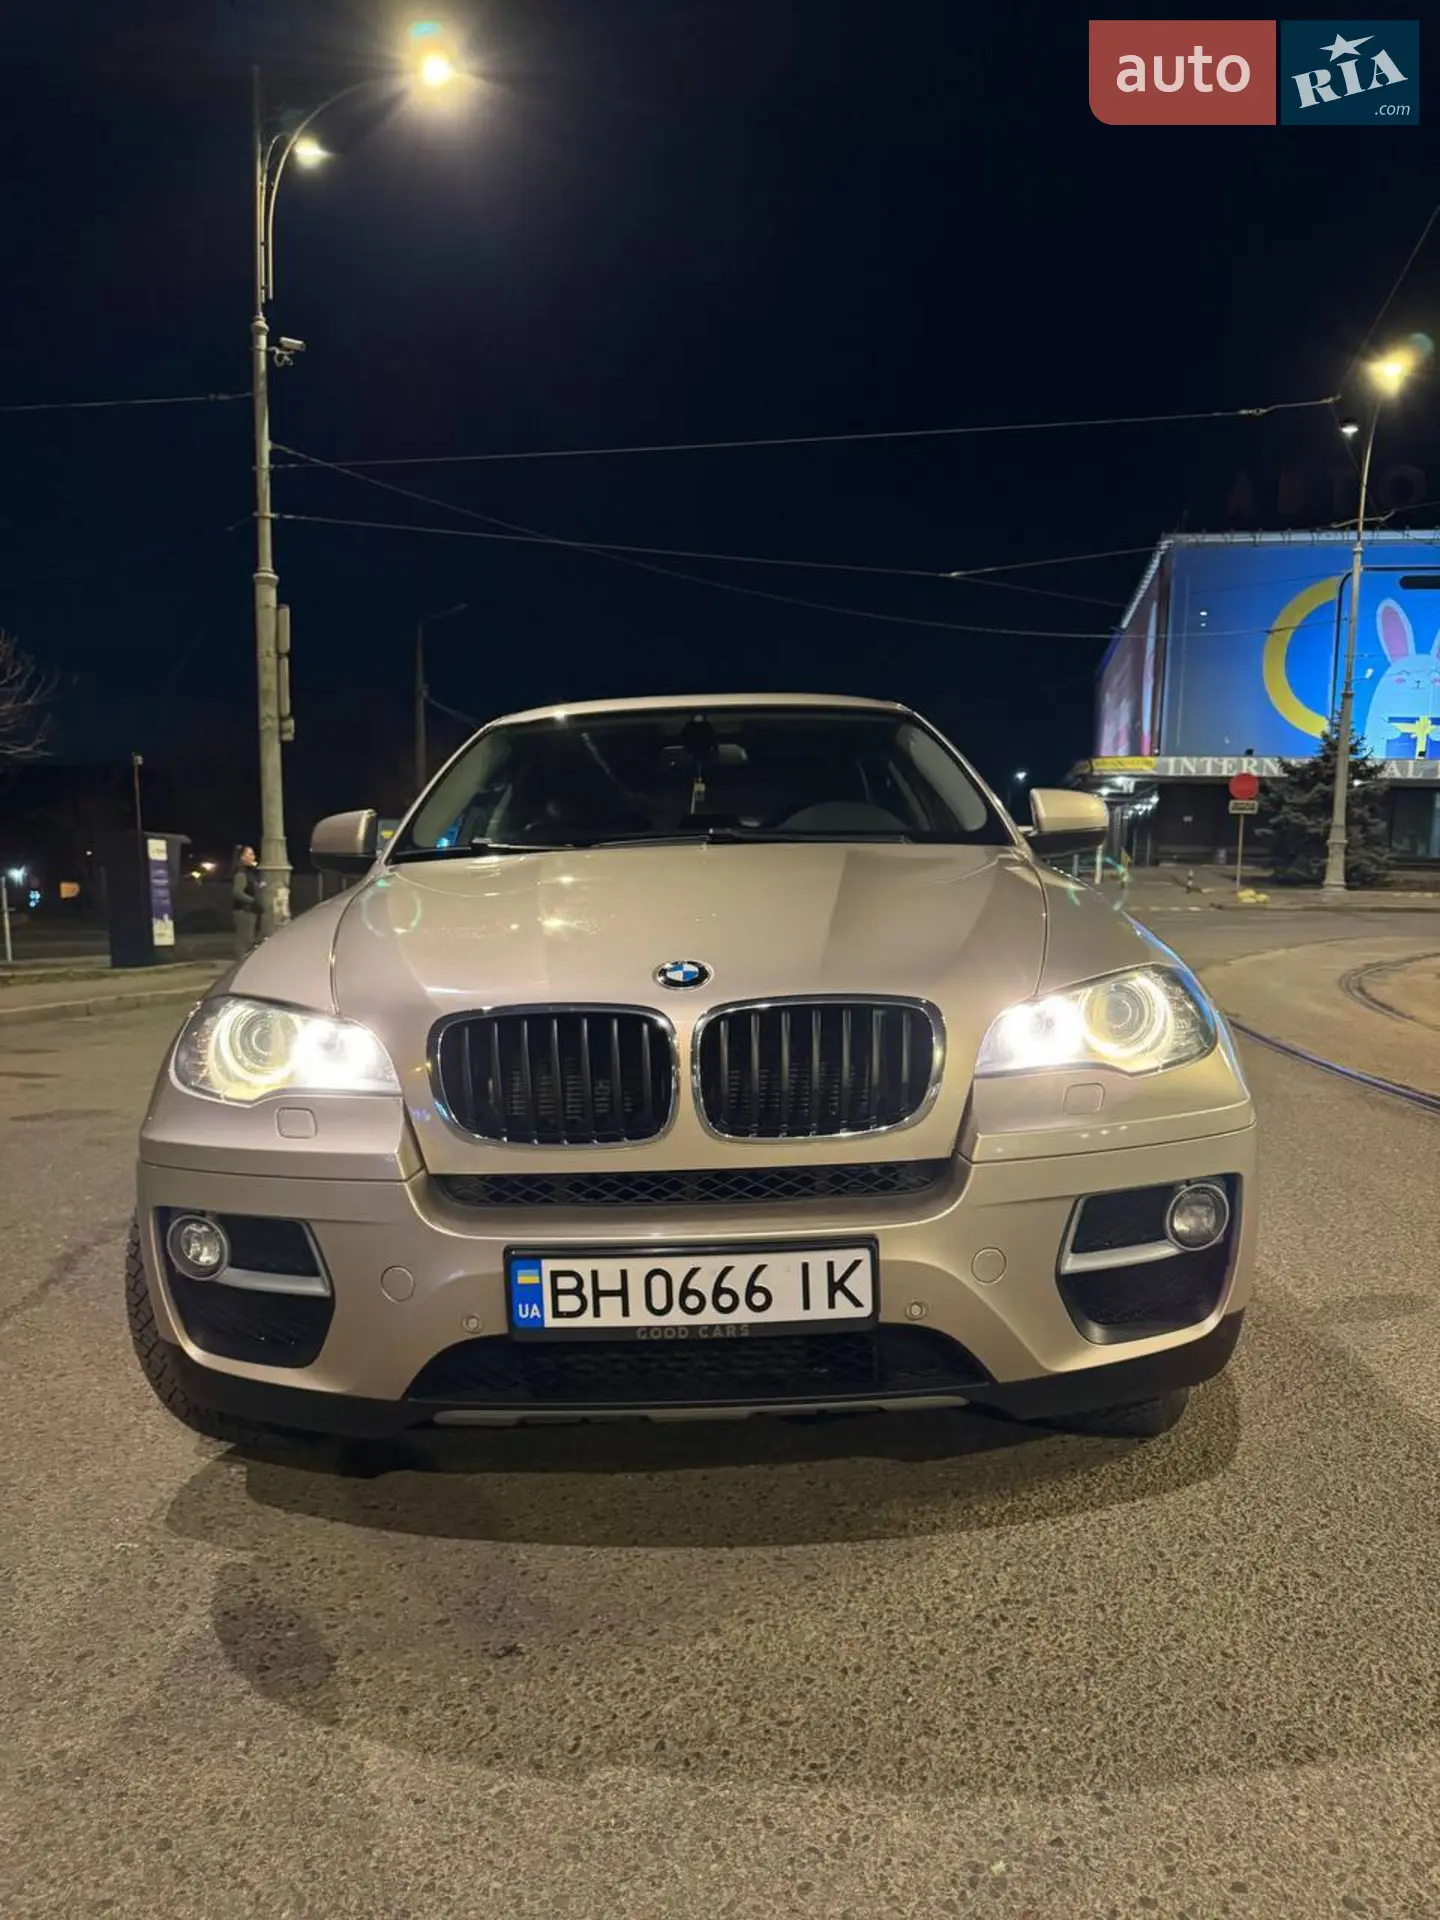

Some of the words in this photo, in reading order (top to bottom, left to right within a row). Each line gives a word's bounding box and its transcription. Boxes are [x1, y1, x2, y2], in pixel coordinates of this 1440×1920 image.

[549, 1268, 631, 1319] BH
[644, 1264, 773, 1317] 0666
[801, 1259, 865, 1311] IK
[518, 1303, 542, 1319] UA
[636, 1326, 689, 1340] GOOD
[698, 1324, 750, 1338] CARS
